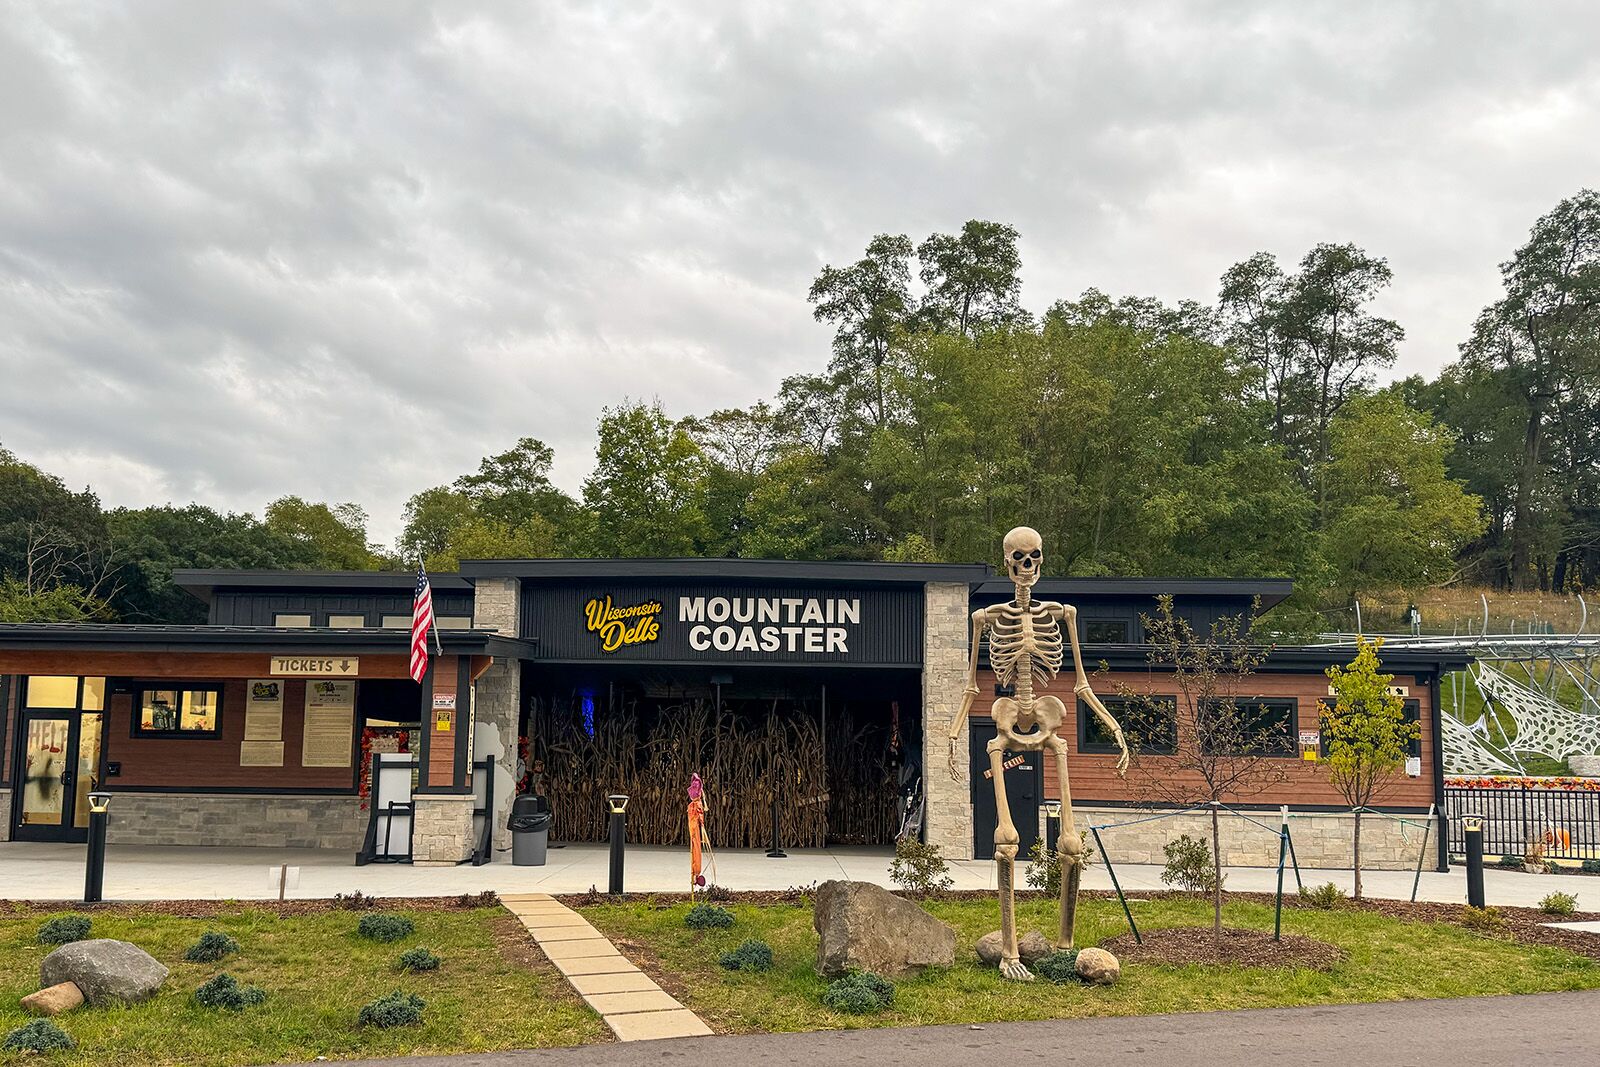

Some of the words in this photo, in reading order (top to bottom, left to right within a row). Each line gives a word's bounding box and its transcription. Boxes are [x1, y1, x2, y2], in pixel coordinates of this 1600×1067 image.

[585, 594, 662, 631] Wisconsin
[679, 596, 861, 625] MOUNTAIN
[600, 616, 660, 652] Dells
[689, 625, 849, 653] COASTER
[277, 659, 333, 672] TICKETS
[29, 720, 68, 753] HELP
